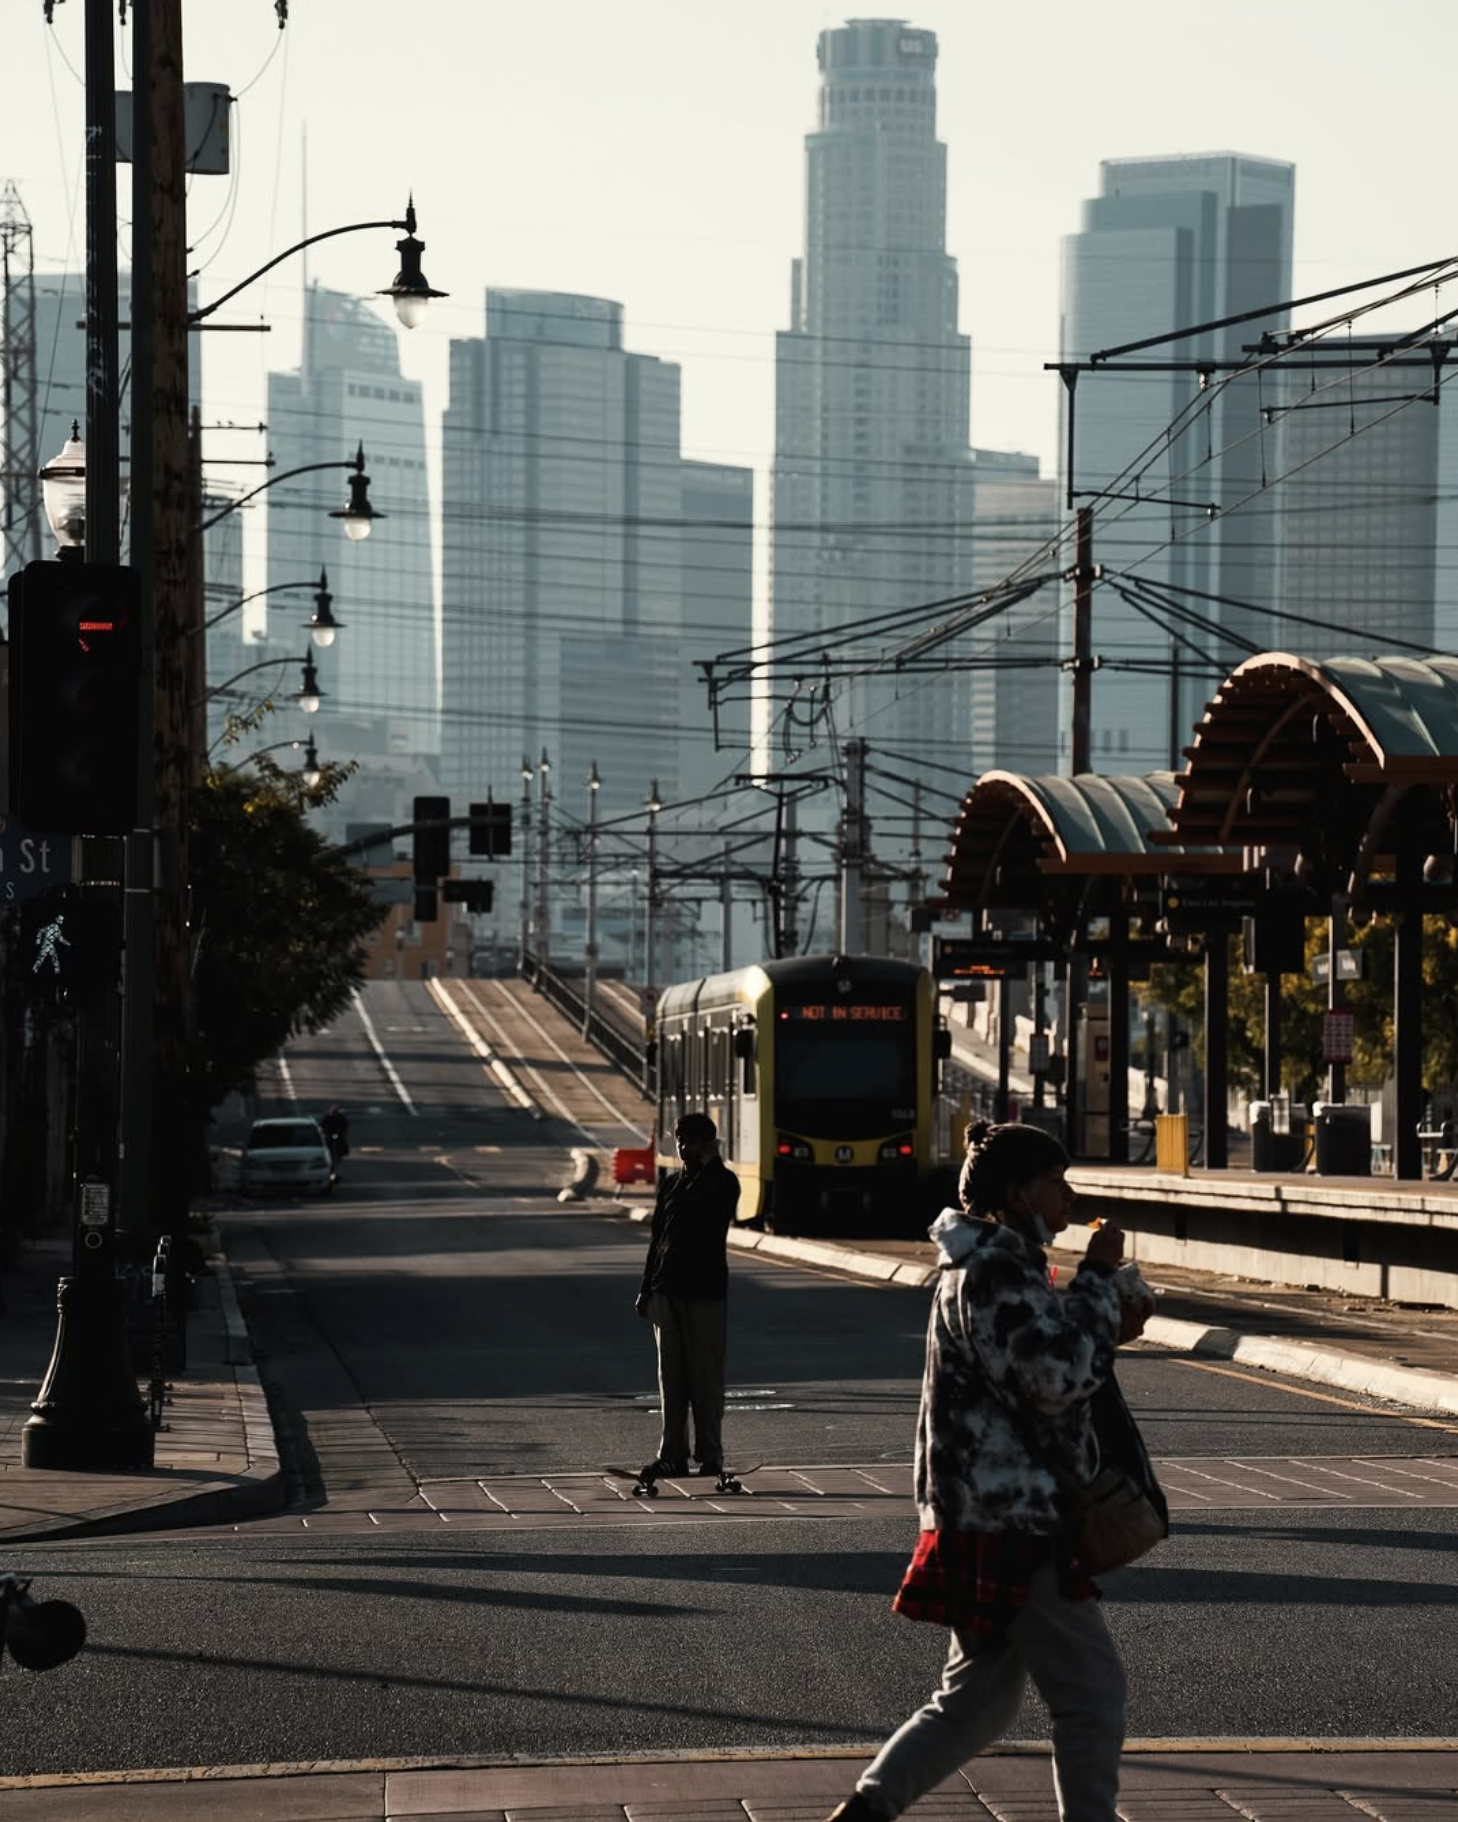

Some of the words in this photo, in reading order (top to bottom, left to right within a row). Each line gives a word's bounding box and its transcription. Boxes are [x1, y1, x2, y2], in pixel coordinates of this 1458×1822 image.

[19, 838, 51, 874] St
[802, 1005, 825, 1019] NOT
[832, 1005, 847, 1018] IN
[850, 1005, 903, 1020] SERVICE
